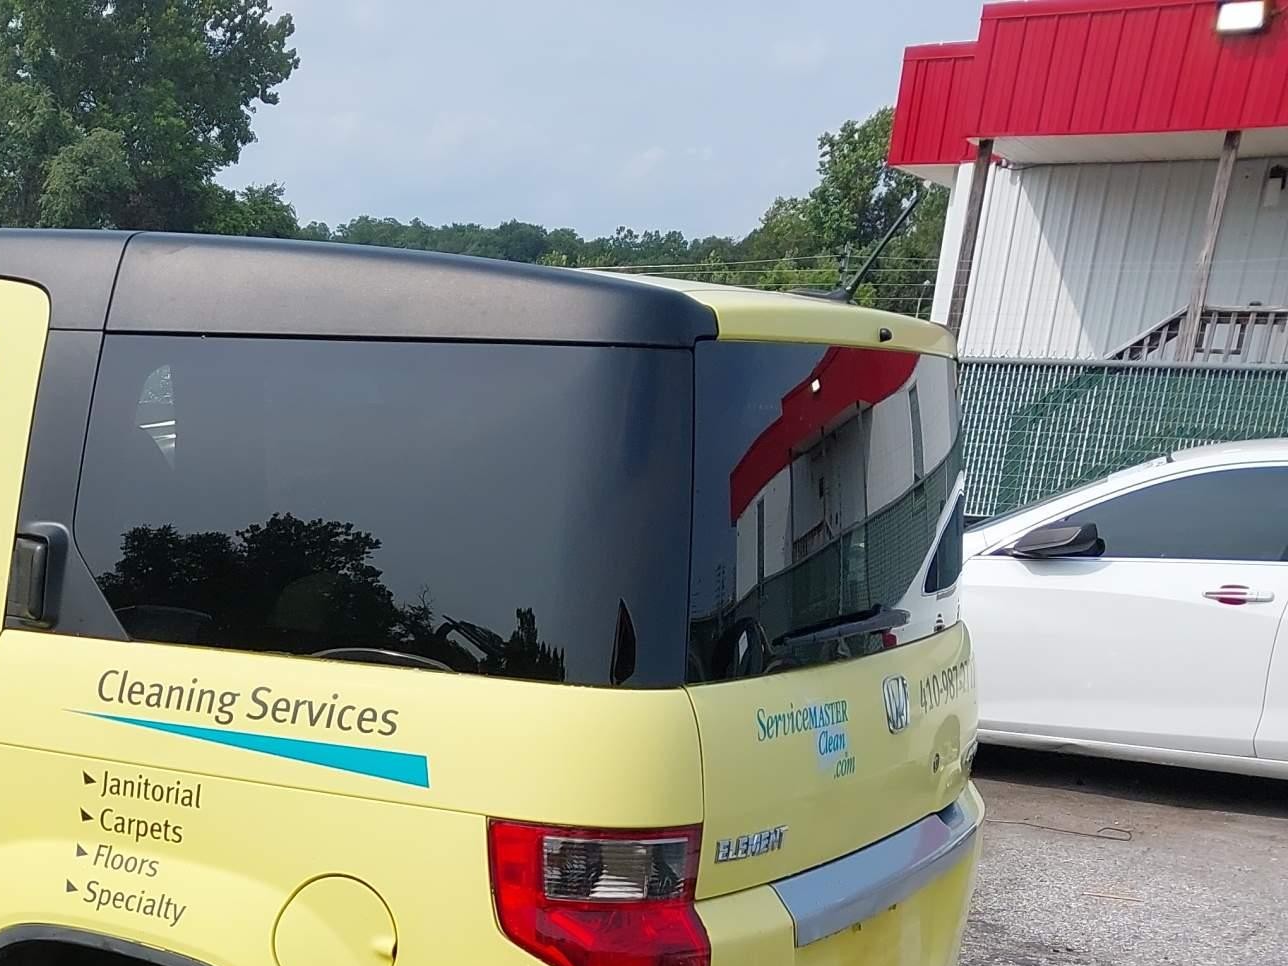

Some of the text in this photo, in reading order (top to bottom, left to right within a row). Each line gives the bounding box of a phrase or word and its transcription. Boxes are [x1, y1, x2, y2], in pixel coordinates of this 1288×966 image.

[97, 669, 399, 736] Cleaning Services
[756, 700, 848, 742] ServiceMASTER
[818, 730, 846, 756] Clean
[833, 756, 856, 780] .com
[100, 771, 201, 808] Janitorial
[99, 808, 183, 843] Carpets
[93, 844, 160, 877] Floors
[714, 825, 789, 864] ELEMENT
[83, 880, 187, 928] Specialty
